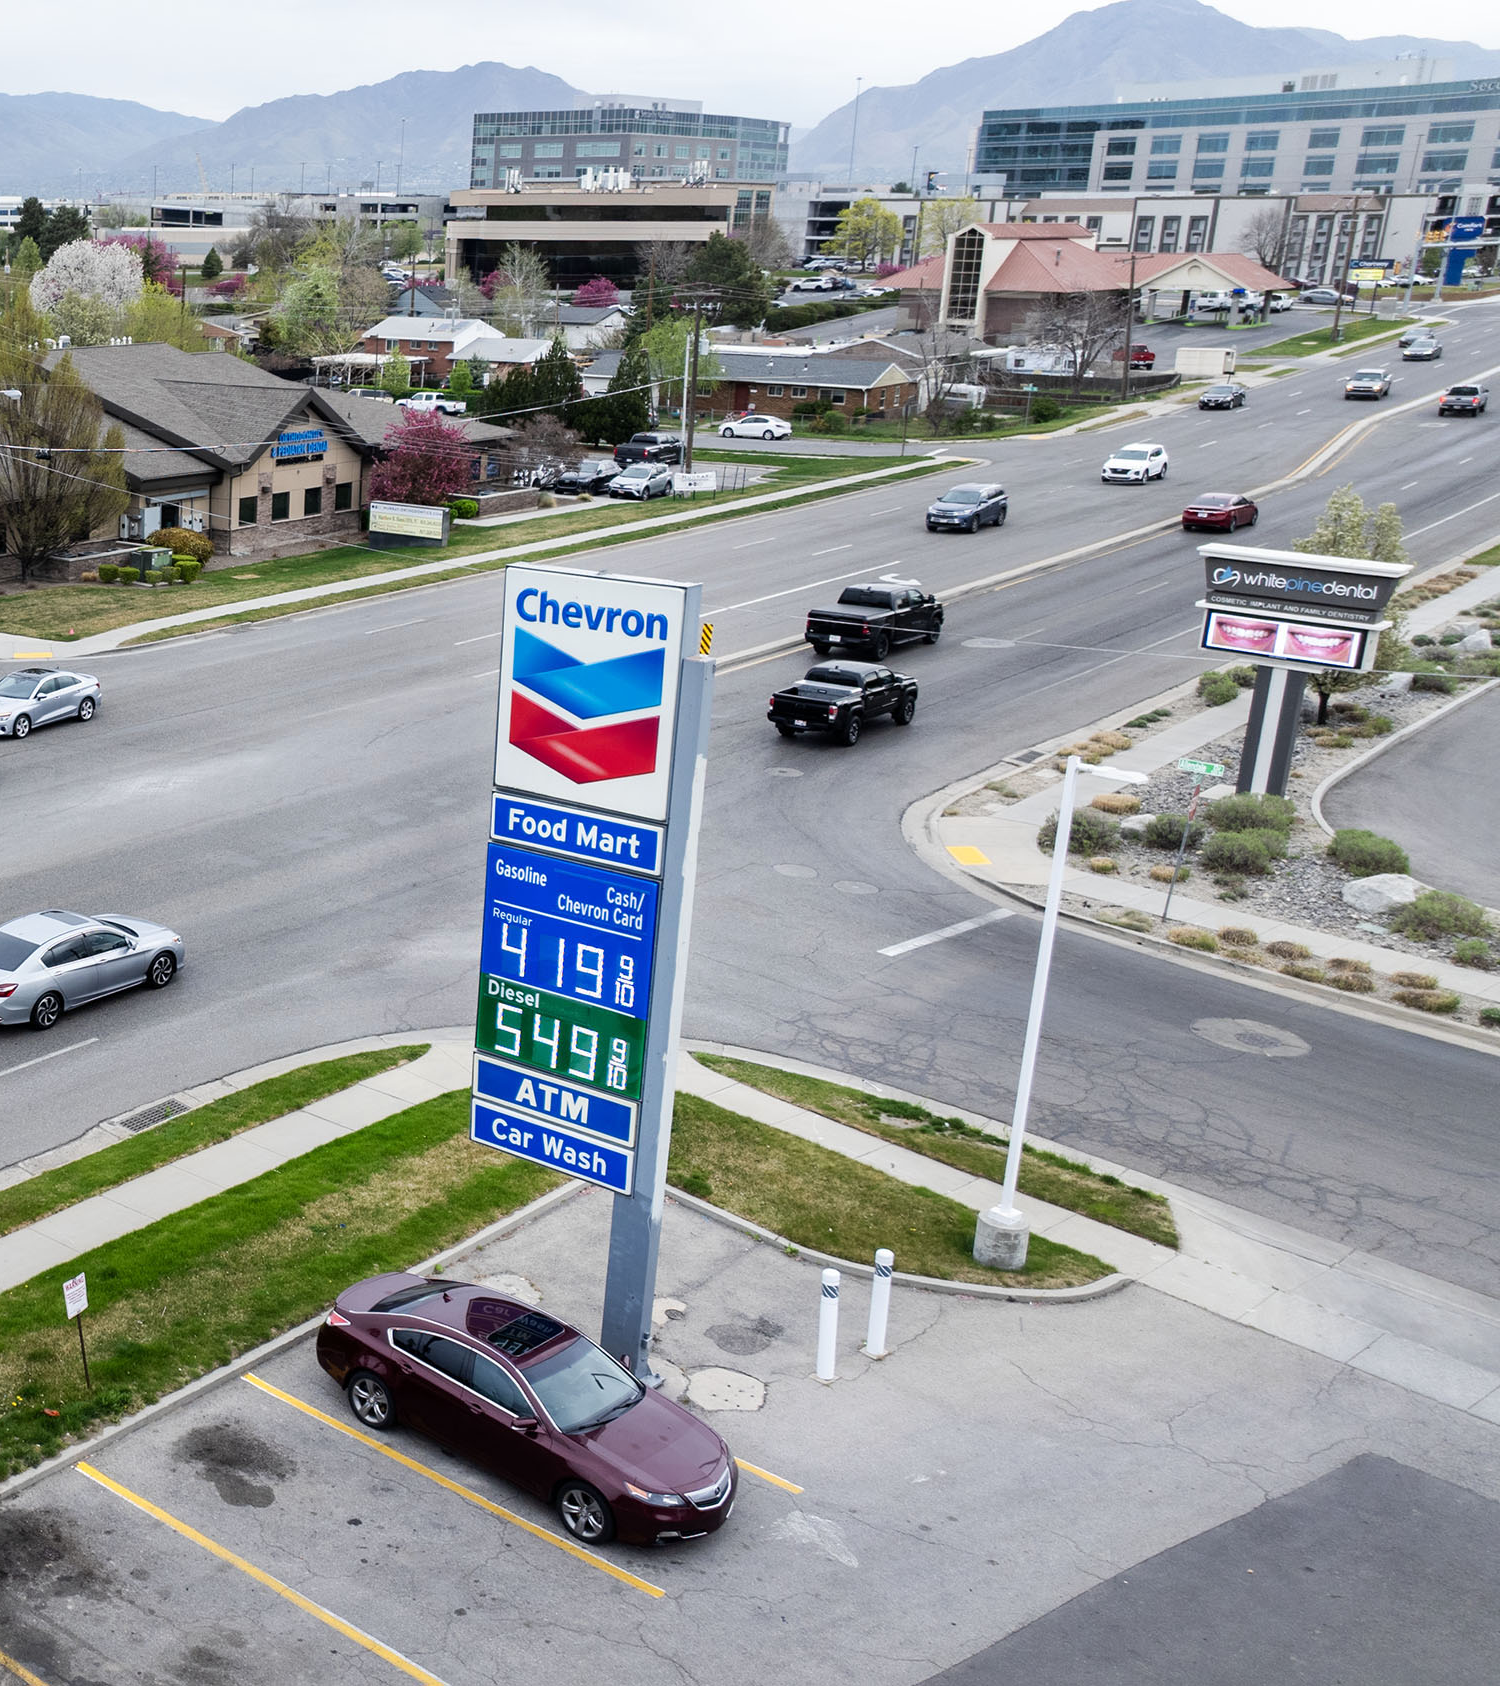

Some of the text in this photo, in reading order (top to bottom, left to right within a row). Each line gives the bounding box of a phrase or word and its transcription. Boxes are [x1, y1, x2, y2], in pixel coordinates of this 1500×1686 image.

[1243, 571, 1378, 600] whitepinedental
[515, 587, 669, 641] Chevron
[1210, 595, 1370, 622] COSMETIC IMPLANT AND FAMILY DENTISTRY
[508, 808, 640, 860] Food Mart
[496, 858, 547, 887] Gasoline
[557, 893, 643, 930] Chevron Card
[606, 886, 646, 912] Cash/
[493, 907, 533, 927] Regular
[488, 979, 540, 1008] Diesel
[515, 1078, 589, 1124] ATM
[492, 1118, 607, 1177] Car Wash
